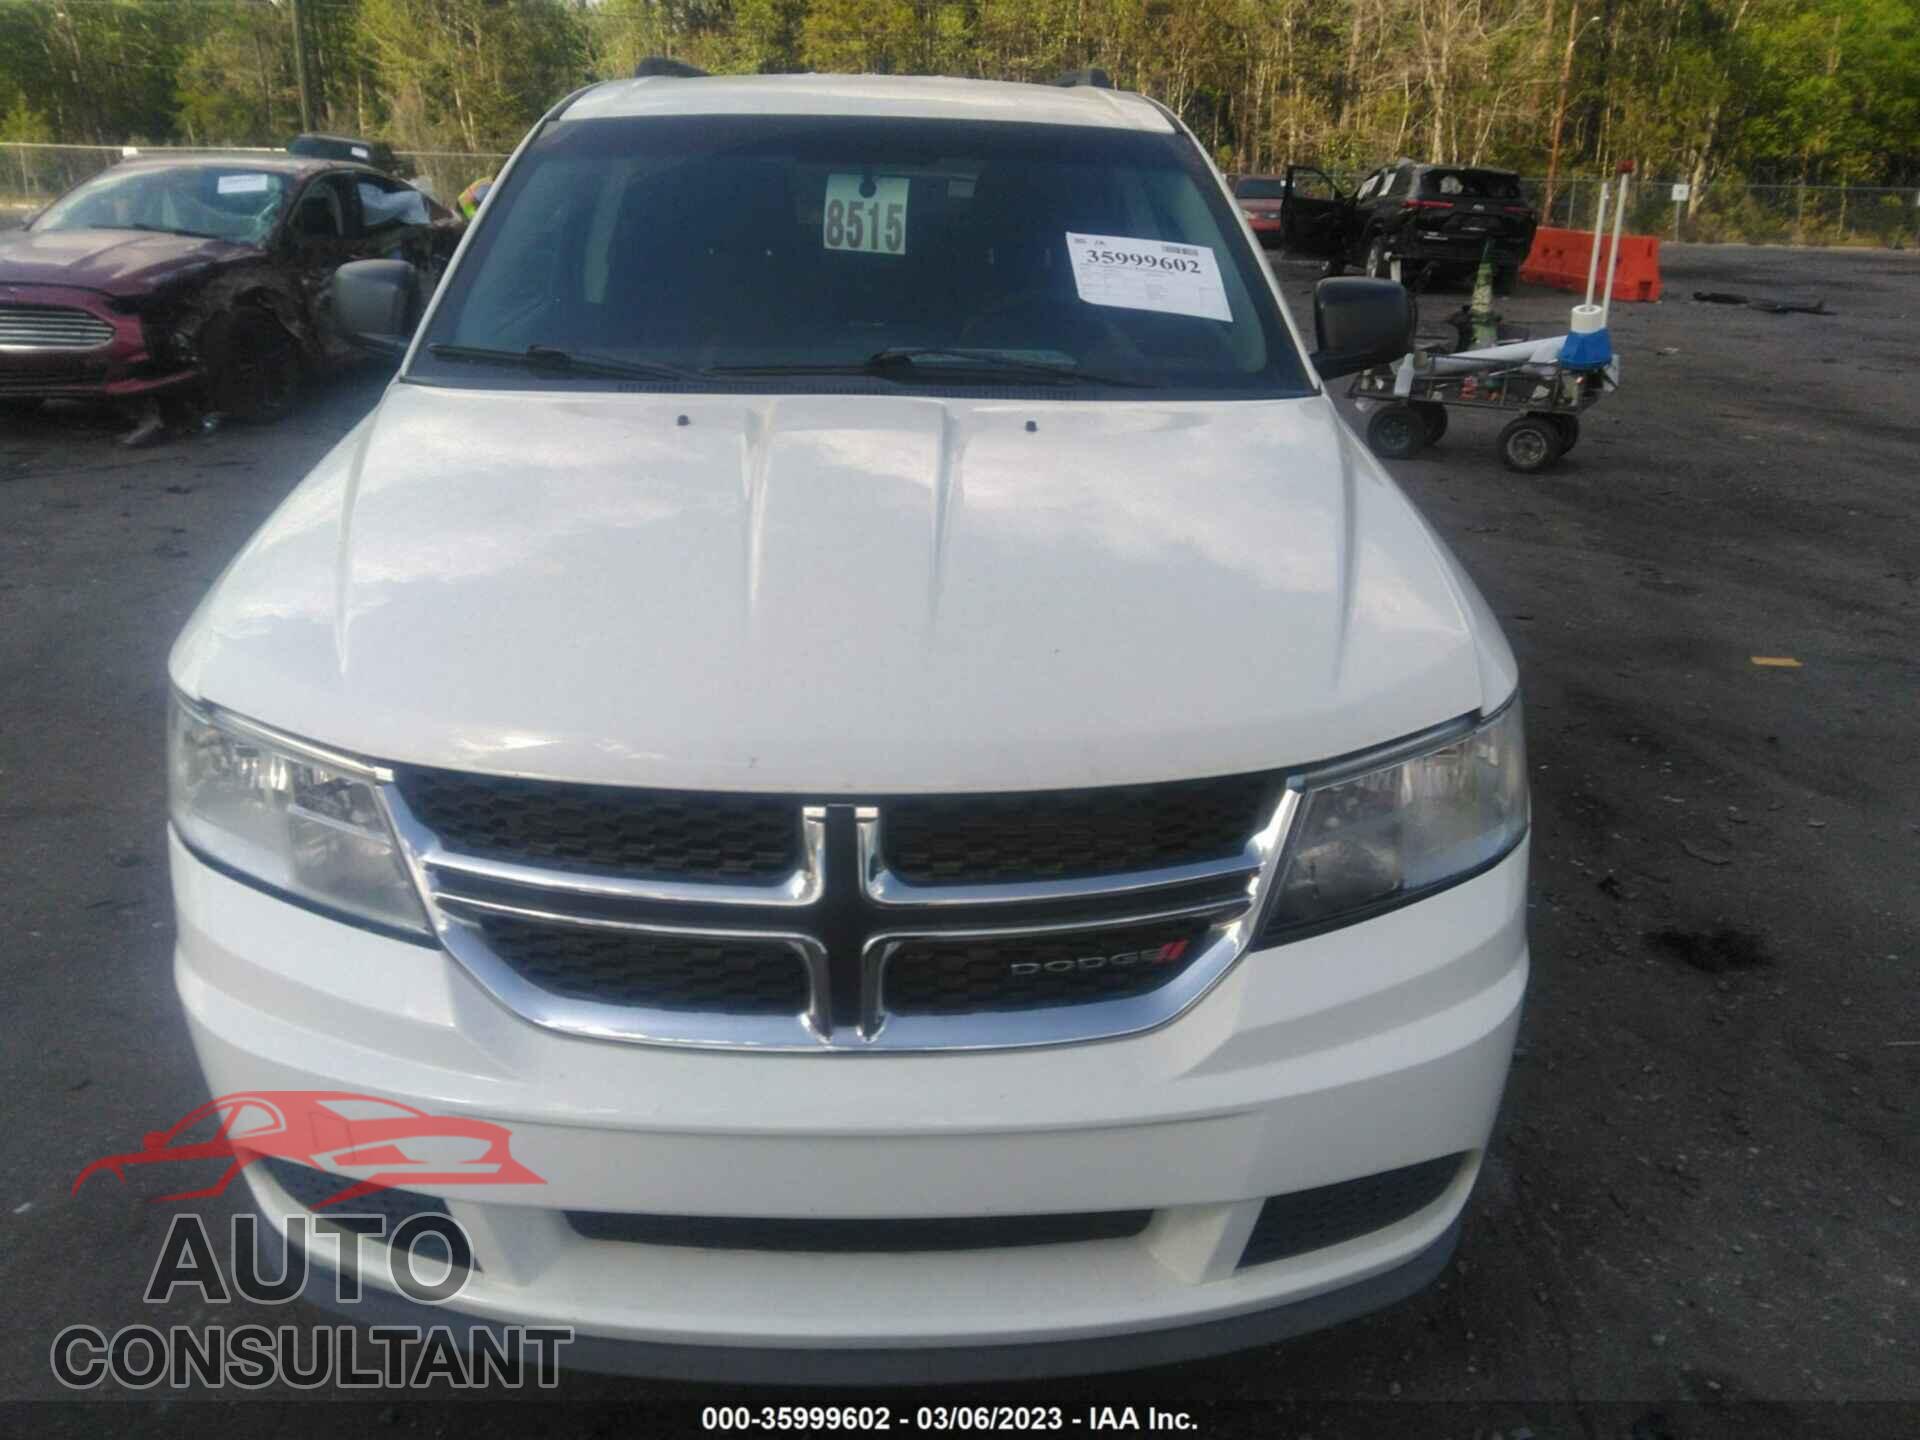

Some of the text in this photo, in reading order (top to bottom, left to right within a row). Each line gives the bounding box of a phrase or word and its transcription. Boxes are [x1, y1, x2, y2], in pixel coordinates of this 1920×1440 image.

[824, 199, 902, 252] 8515
[1086, 249, 1201, 274] 35999602
[1010, 948, 1162, 975] DODGE
